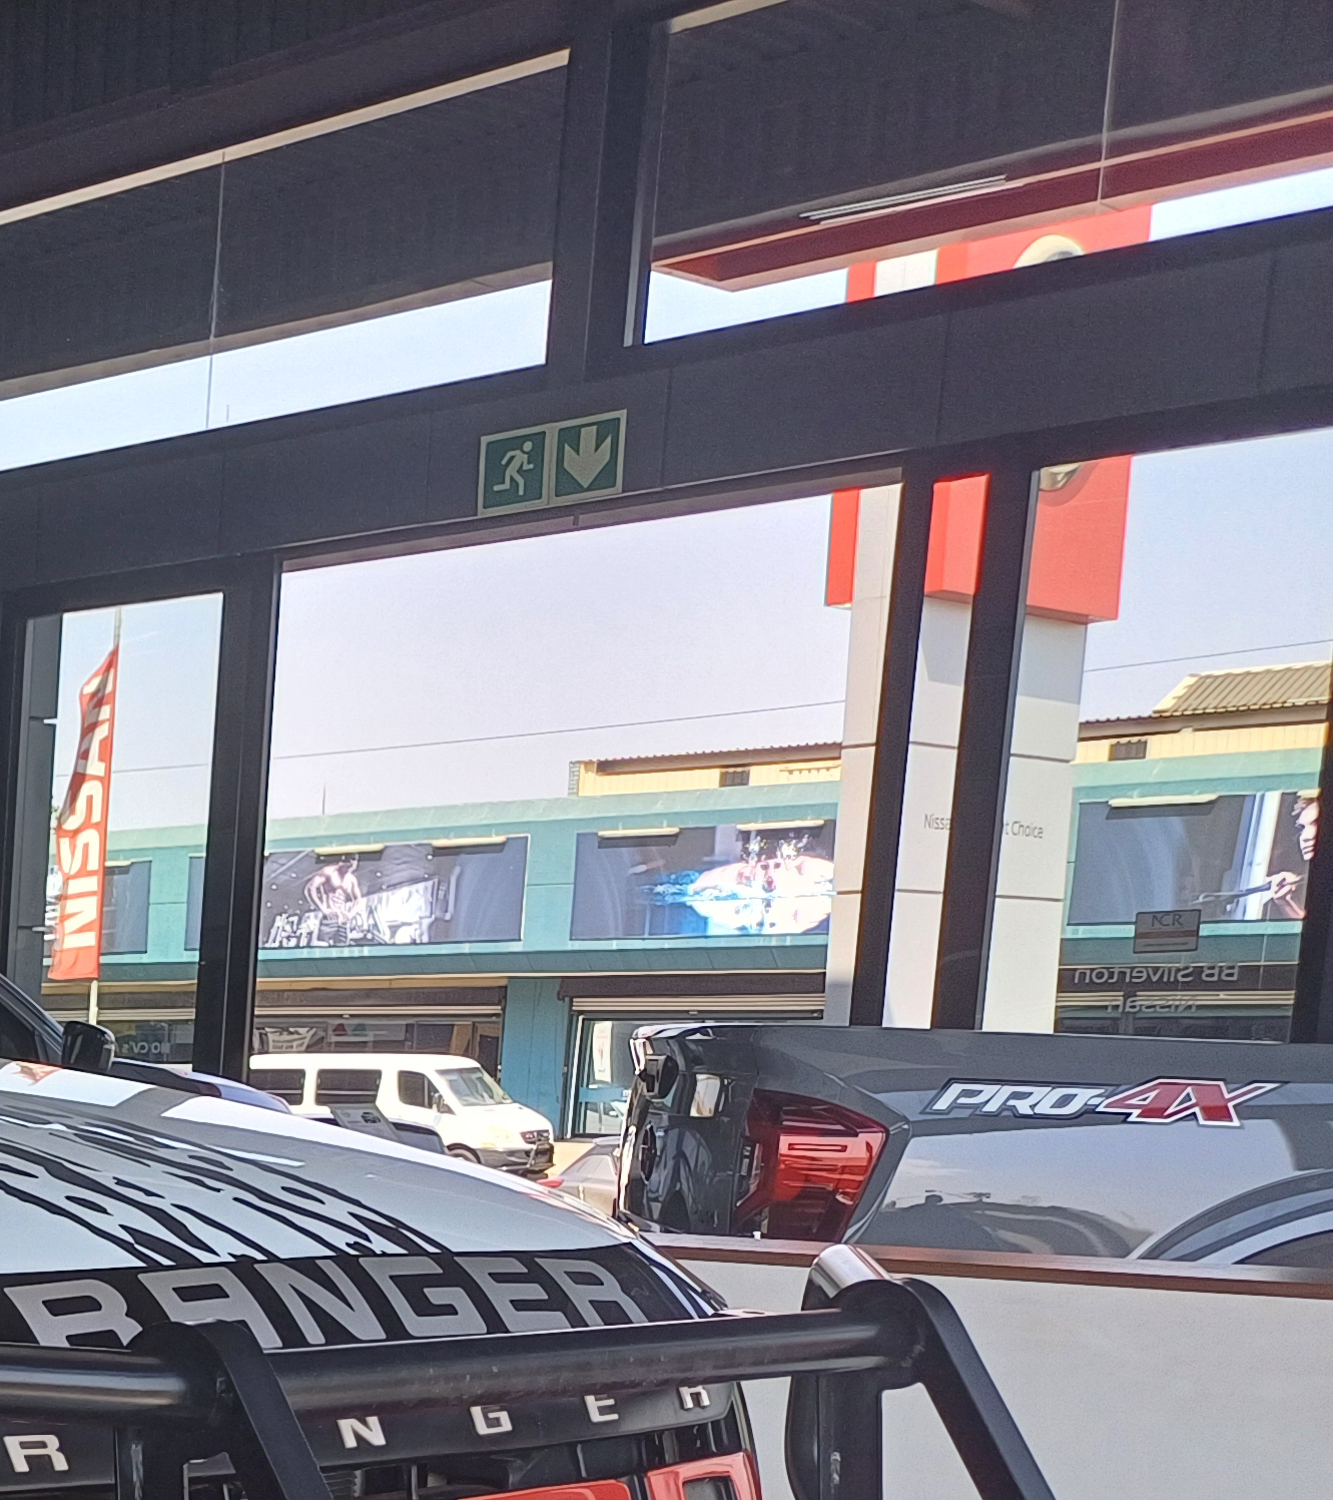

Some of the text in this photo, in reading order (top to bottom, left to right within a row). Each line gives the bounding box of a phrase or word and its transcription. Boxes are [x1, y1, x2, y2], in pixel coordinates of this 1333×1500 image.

[59, 668, 116, 950] NISSAN
[924, 813, 952, 831] Nissa
[1011, 820, 1044, 839] Choice
[933, 1077, 1282, 1127] PRO-4X
[4, 1256, 648, 1349] RANGER
[2, 1384, 712, 1473] RNGER
